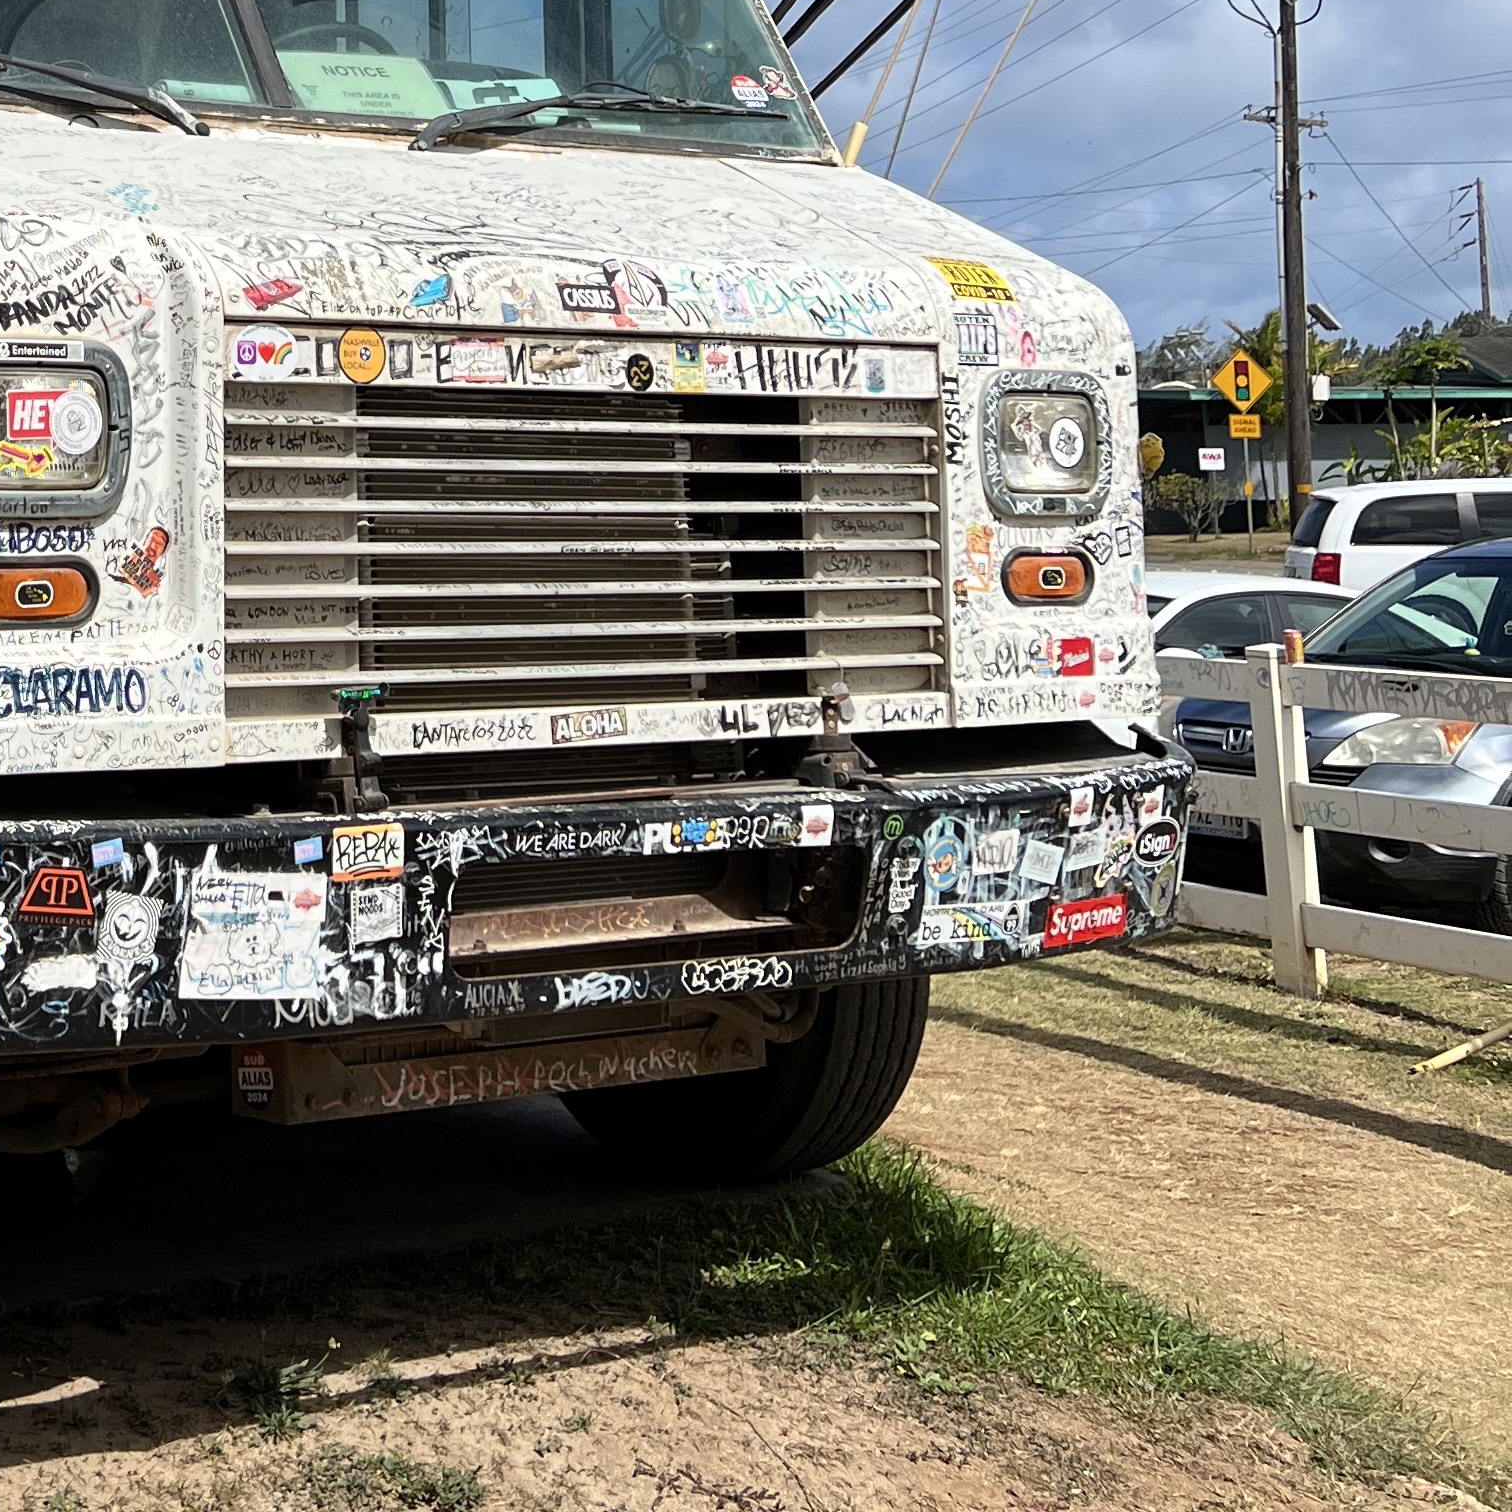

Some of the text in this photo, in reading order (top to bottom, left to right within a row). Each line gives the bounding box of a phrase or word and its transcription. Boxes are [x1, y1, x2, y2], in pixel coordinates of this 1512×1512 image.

[321, 65, 390, 78] NOTICE
[342, 91, 363, 99] THIS
[365, 92, 390, 100] AREA
[737, 89, 765, 98] ALIAS
[360, 100, 393, 108] UNDER
[563, 287, 616, 310] CASSIUS
[343, 338, 381, 347] NASHVILLE
[12, 344, 67, 357] Entertained
[343, 350, 357, 359] BUY
[1233, 418, 1257, 426] SIGNAL
[555, 710, 624, 740] ALOHA
[515, 829, 622, 852] WE ARE DARK
[891, 889, 913, 900] Good
[71, 916, 94, 926] PACK
[1050, 904, 1123, 941] Supreme
[922, 916, 998, 940] be kind.
[244, 1056, 265, 1066] SUB
[241, 1071, 271, 1086] ALIAS
[381, 1063, 521, 1107] JOSEPH
[247, 1092, 268, 1103] 2024
